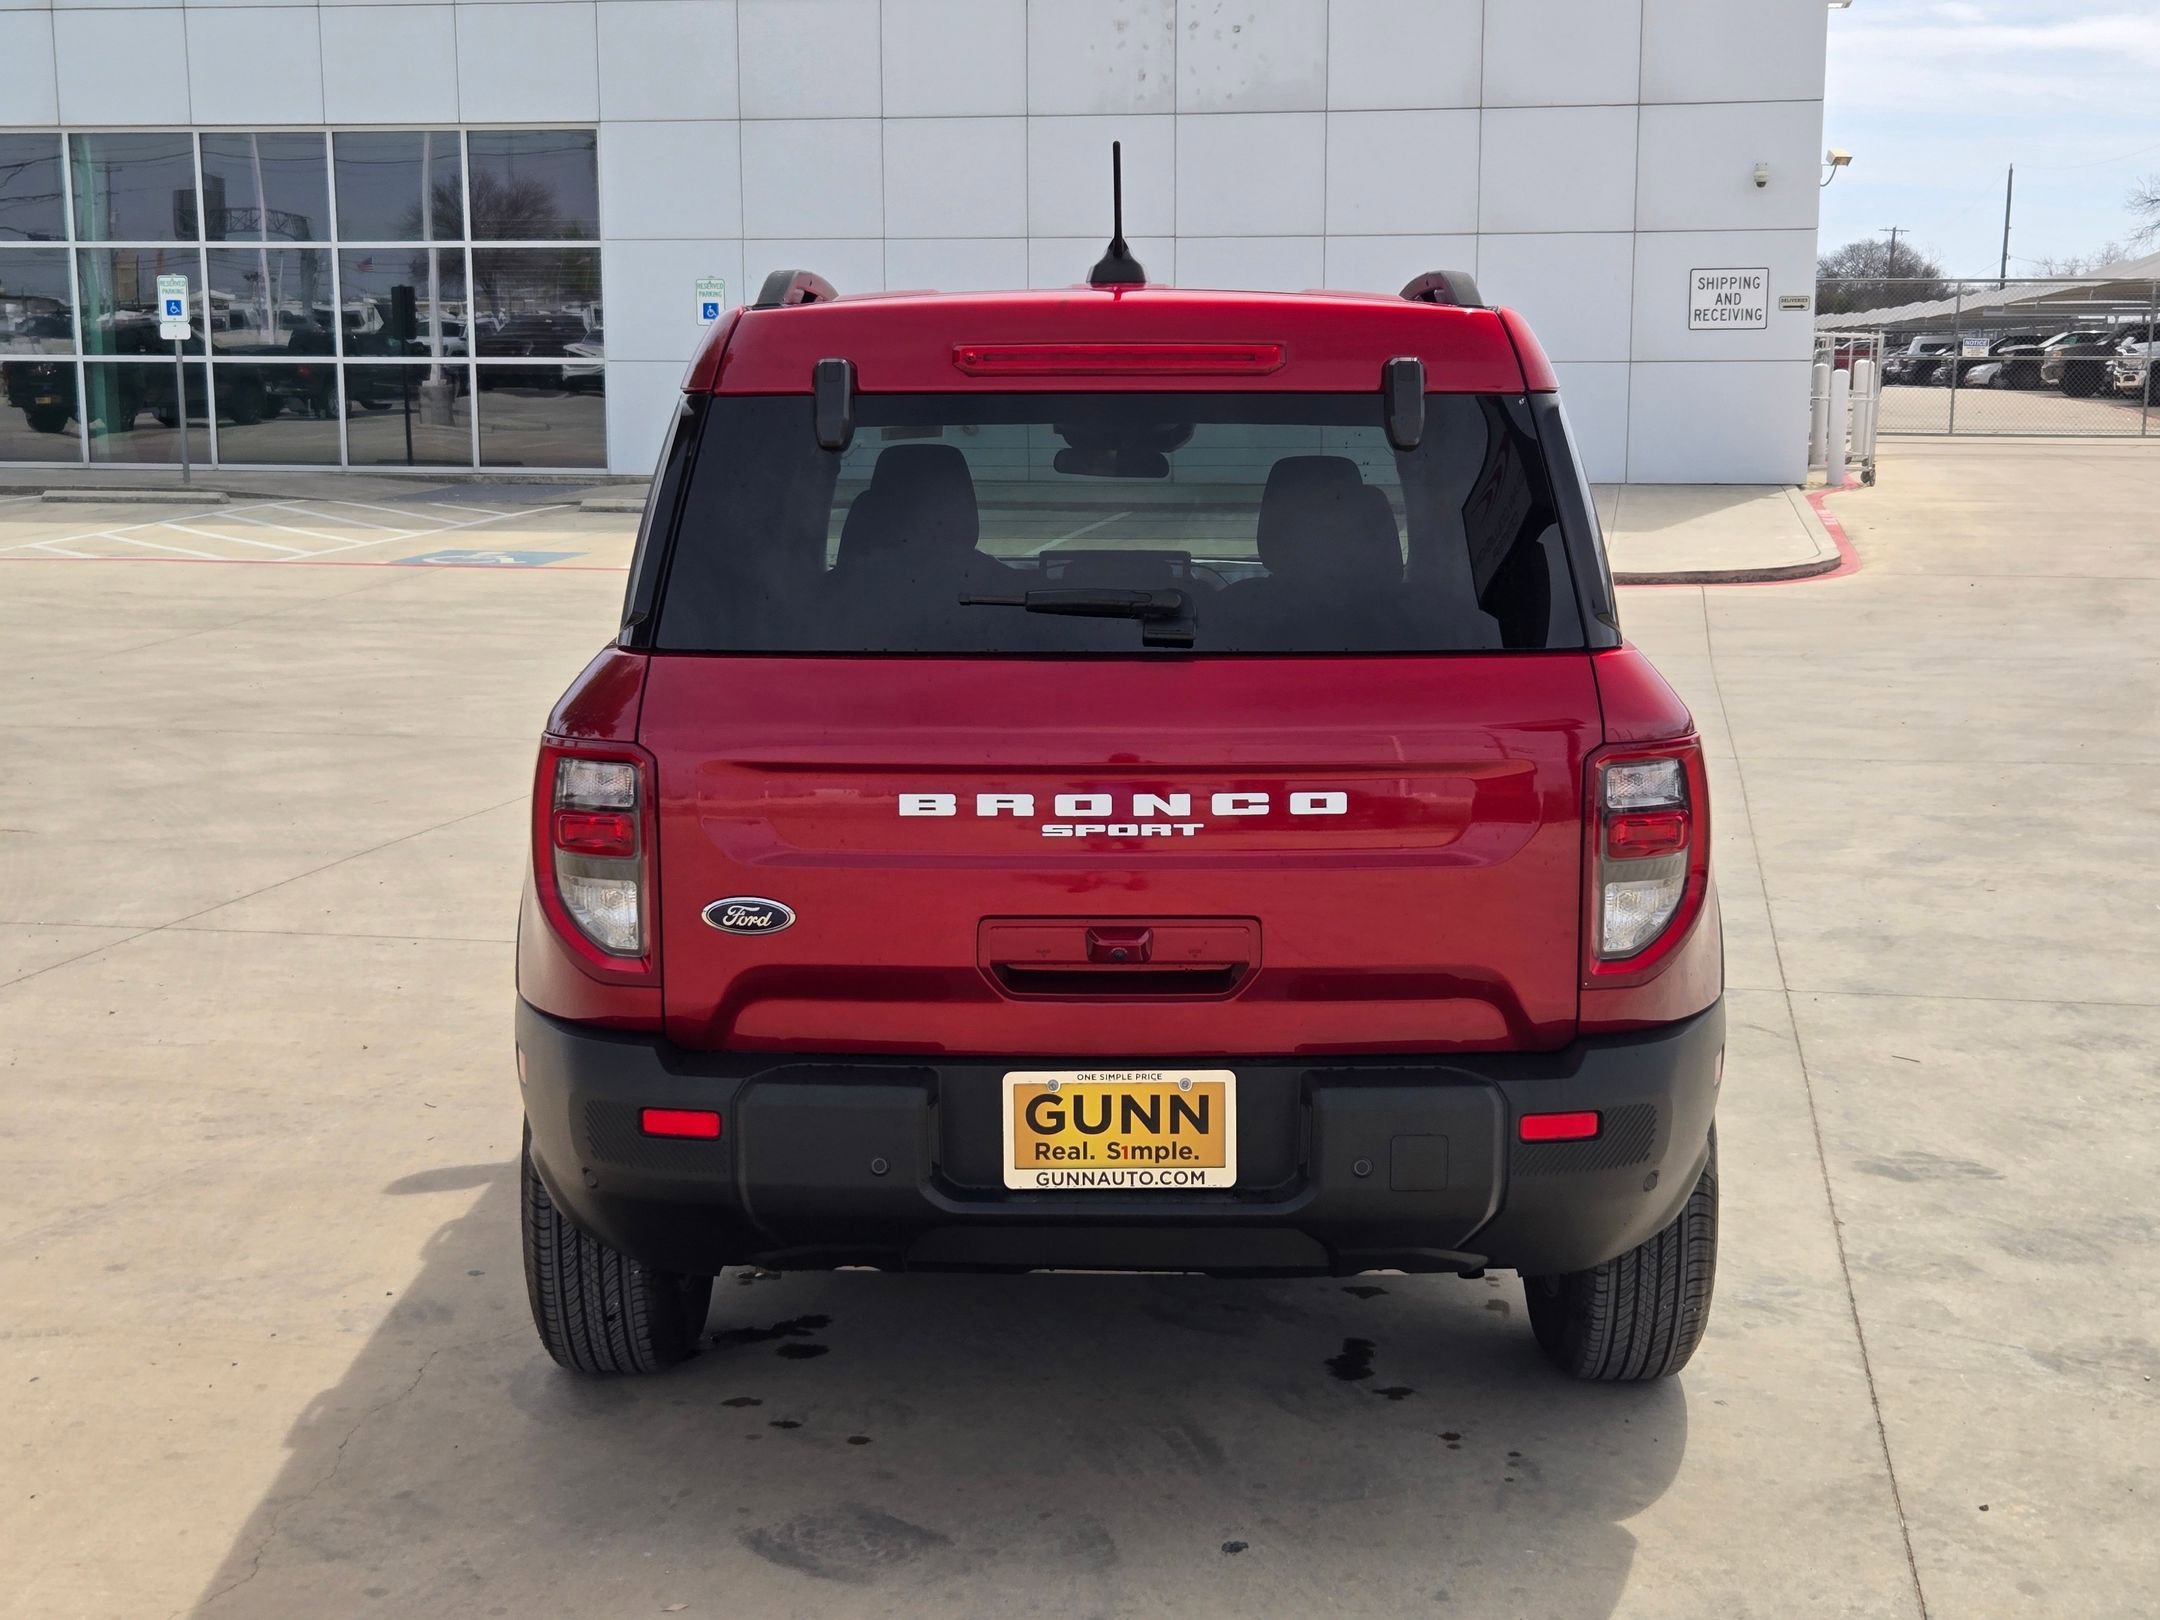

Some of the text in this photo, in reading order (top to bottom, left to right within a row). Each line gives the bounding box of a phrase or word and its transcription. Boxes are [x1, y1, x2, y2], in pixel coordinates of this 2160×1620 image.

[1697, 276, 1761, 290] SHIPPING
[1715, 292, 1742, 306] AND
[1694, 308, 1763, 322] RECEIVING
[899, 791, 1348, 817] BRONCO
[1041, 823, 1205, 837] SPORT
[722, 905, 773, 927] Ford
[1076, 1072, 1163, 1081] ONE SIMPLE PRICE
[1025, 1093, 1209, 1135] GUNN
[1035, 1141, 1096, 1161] Real.
[1036, 1170, 1206, 1187] GUNNAUTO.COM
